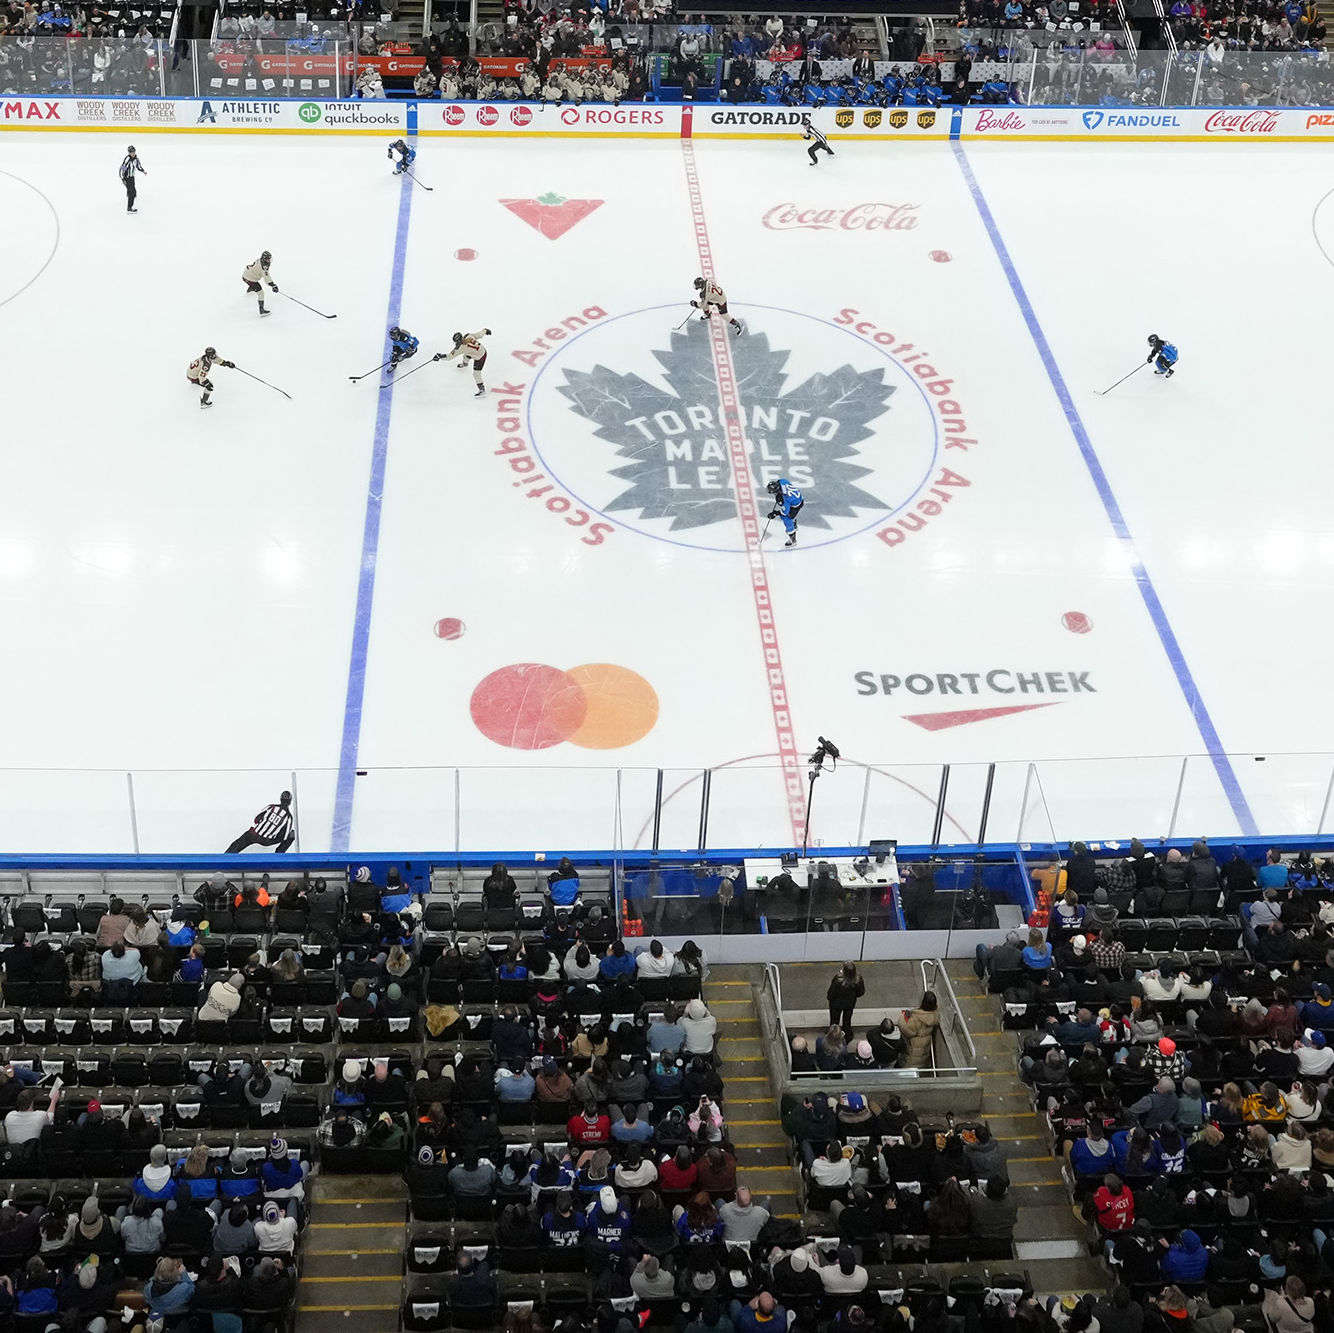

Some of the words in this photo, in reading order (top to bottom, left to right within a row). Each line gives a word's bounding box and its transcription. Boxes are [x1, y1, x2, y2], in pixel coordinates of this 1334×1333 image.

[261, 60, 270, 69] G
[304, 60, 313, 69] G
[388, 61, 398, 70] G
[76, 101, 105, 109] WOODY
[222, 102, 280, 114] ATHLETIC
[325, 103, 362, 111] INTUIT
[325, 113, 399, 126] quickbooks
[585, 109, 664, 124] ROGERS
[710, 111, 812, 126] GATORADE
[835, 113, 854, 126] ups
[864, 113, 882, 126] ups
[890, 113, 908, 126] ups
[917, 113, 935, 126] ups
[975, 108, 1026, 132] Barbie
[1107, 115, 1181, 127] FANDUEL
[1204, 110, 1283, 133] Coca-Cola
[761, 202, 922, 231] Coca-Cola
[510, 304, 609, 369] Arena
[832, 306, 979, 452] Scotiabank
[490, 380, 616, 547] Scotiabank
[875, 465, 972, 548] Arena
[853, 668, 1098, 696] SPORTCHEK
[597, 1227, 622, 1236] MARNER
